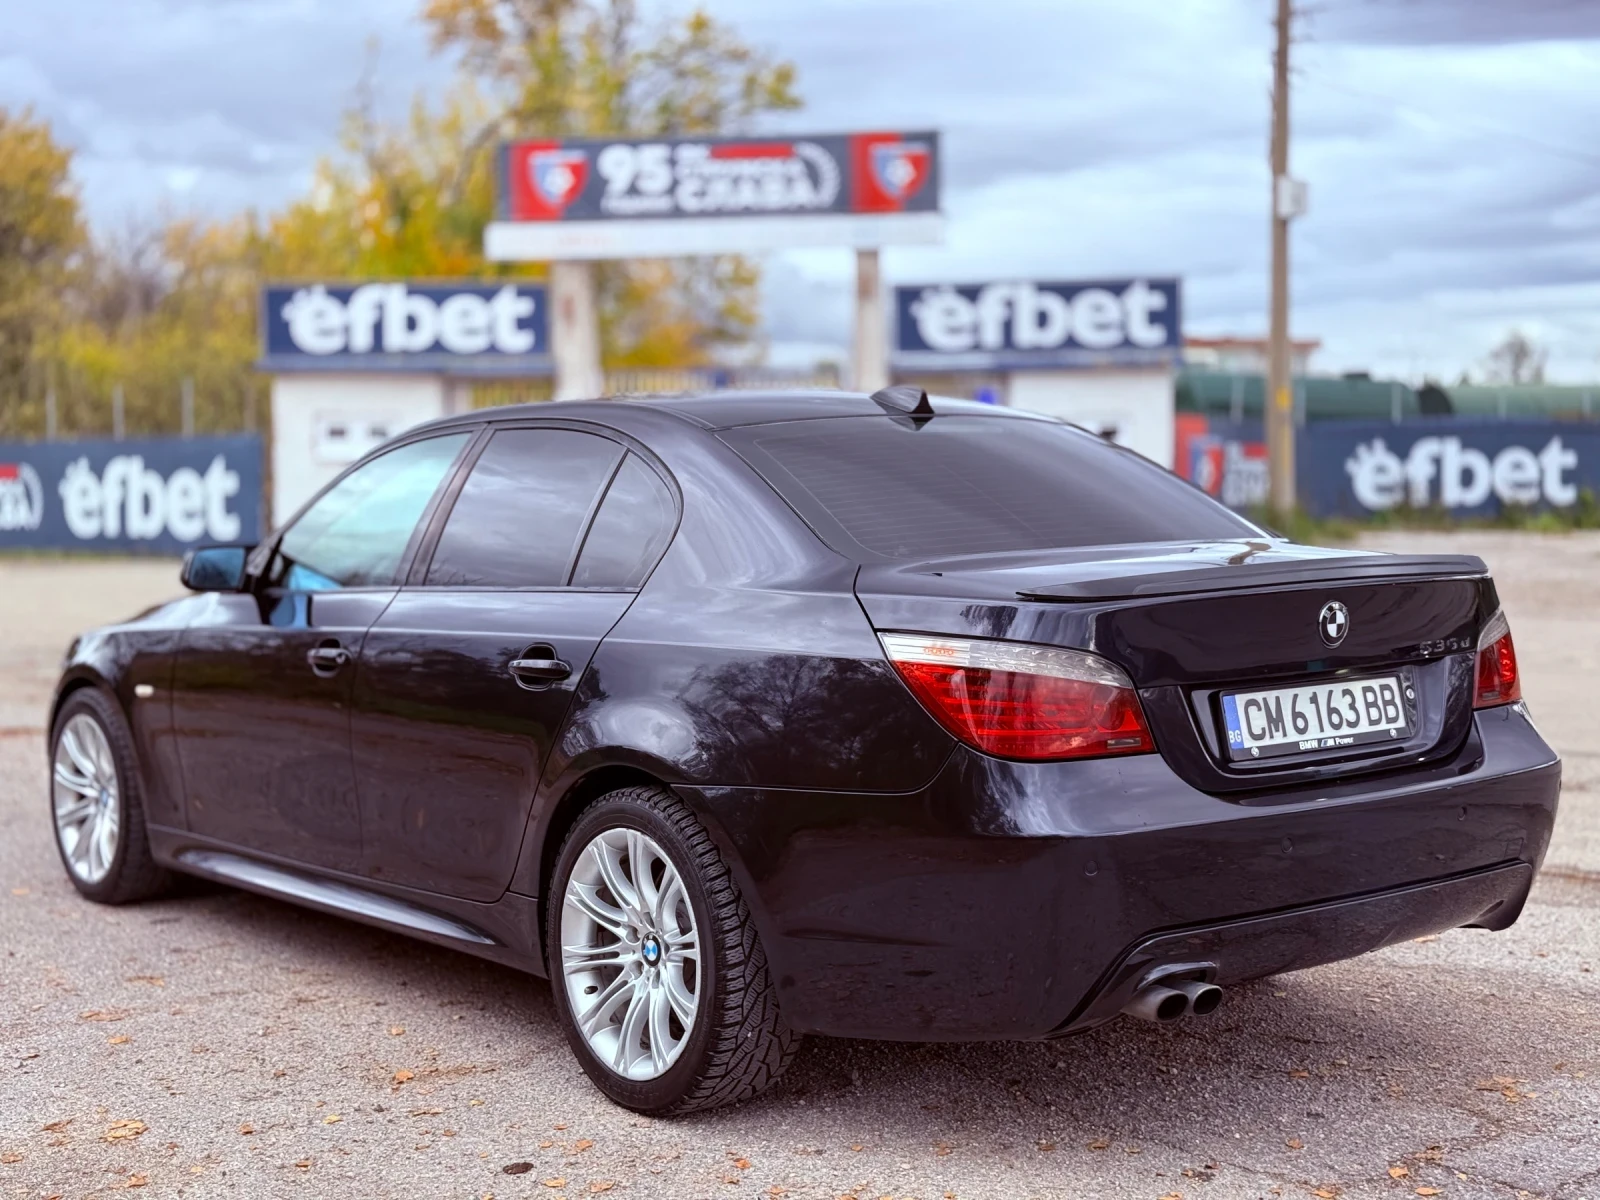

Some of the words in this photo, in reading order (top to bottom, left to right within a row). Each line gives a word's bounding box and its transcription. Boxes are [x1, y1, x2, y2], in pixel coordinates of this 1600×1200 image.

[597, 143, 673, 197] 95
[282, 284, 536, 354] efbet
[909, 280, 1168, 350] efbet
[59, 455, 241, 542] efbet
[1346, 436, 1578, 510] efbet
[1228, 730, 1241, 743] BG
[1243, 695, 1288, 741] CM
[1291, 688, 1361, 735] 6163
[1361, 683, 1400, 727] BB
[1299, 739, 1318, 750] BMW
[1335, 736, 1354, 745] Power
